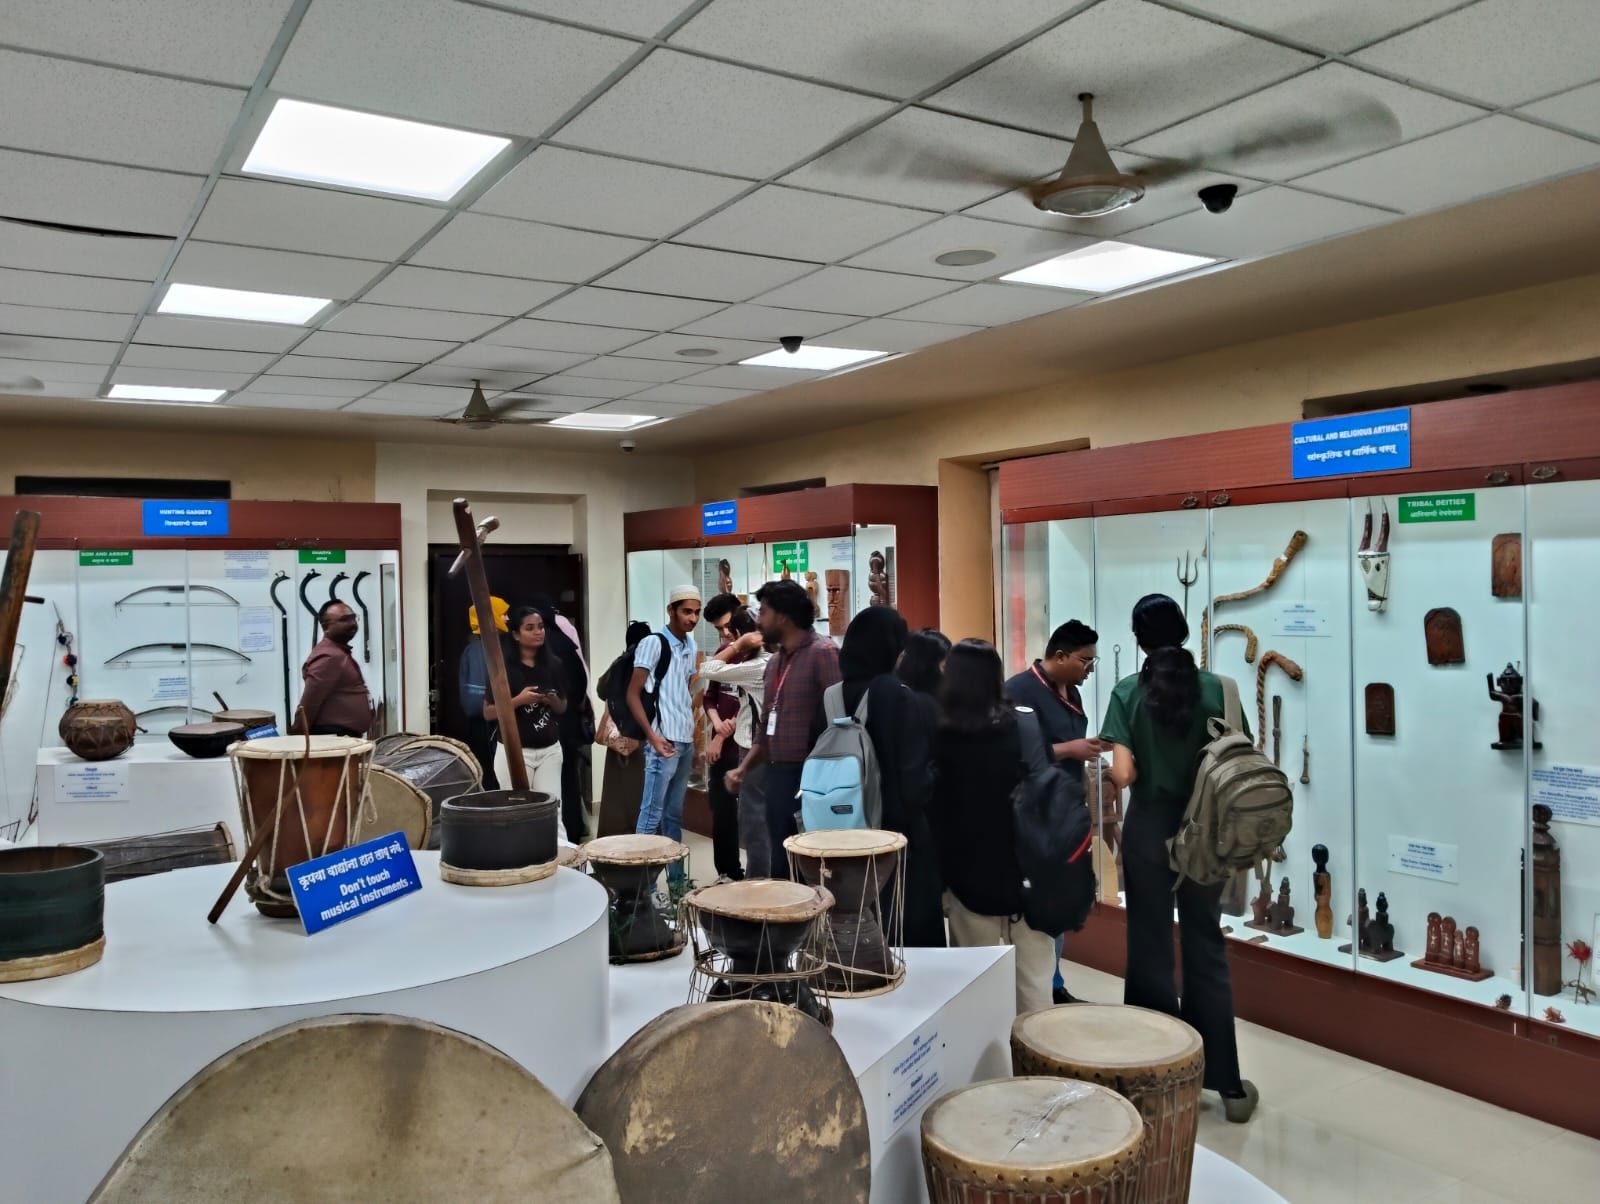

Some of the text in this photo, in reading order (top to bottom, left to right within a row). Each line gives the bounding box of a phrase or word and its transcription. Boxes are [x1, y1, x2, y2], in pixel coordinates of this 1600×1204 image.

[1294, 422, 1408, 444] CULTURAL AND RELIGIOUS ARTIFACTS
[1436, 498, 1466, 506] DEITIES
[298, 868, 326, 892] कृपया
[340, 868, 390, 896] Don't touch
[320, 897, 359, 921] musical
